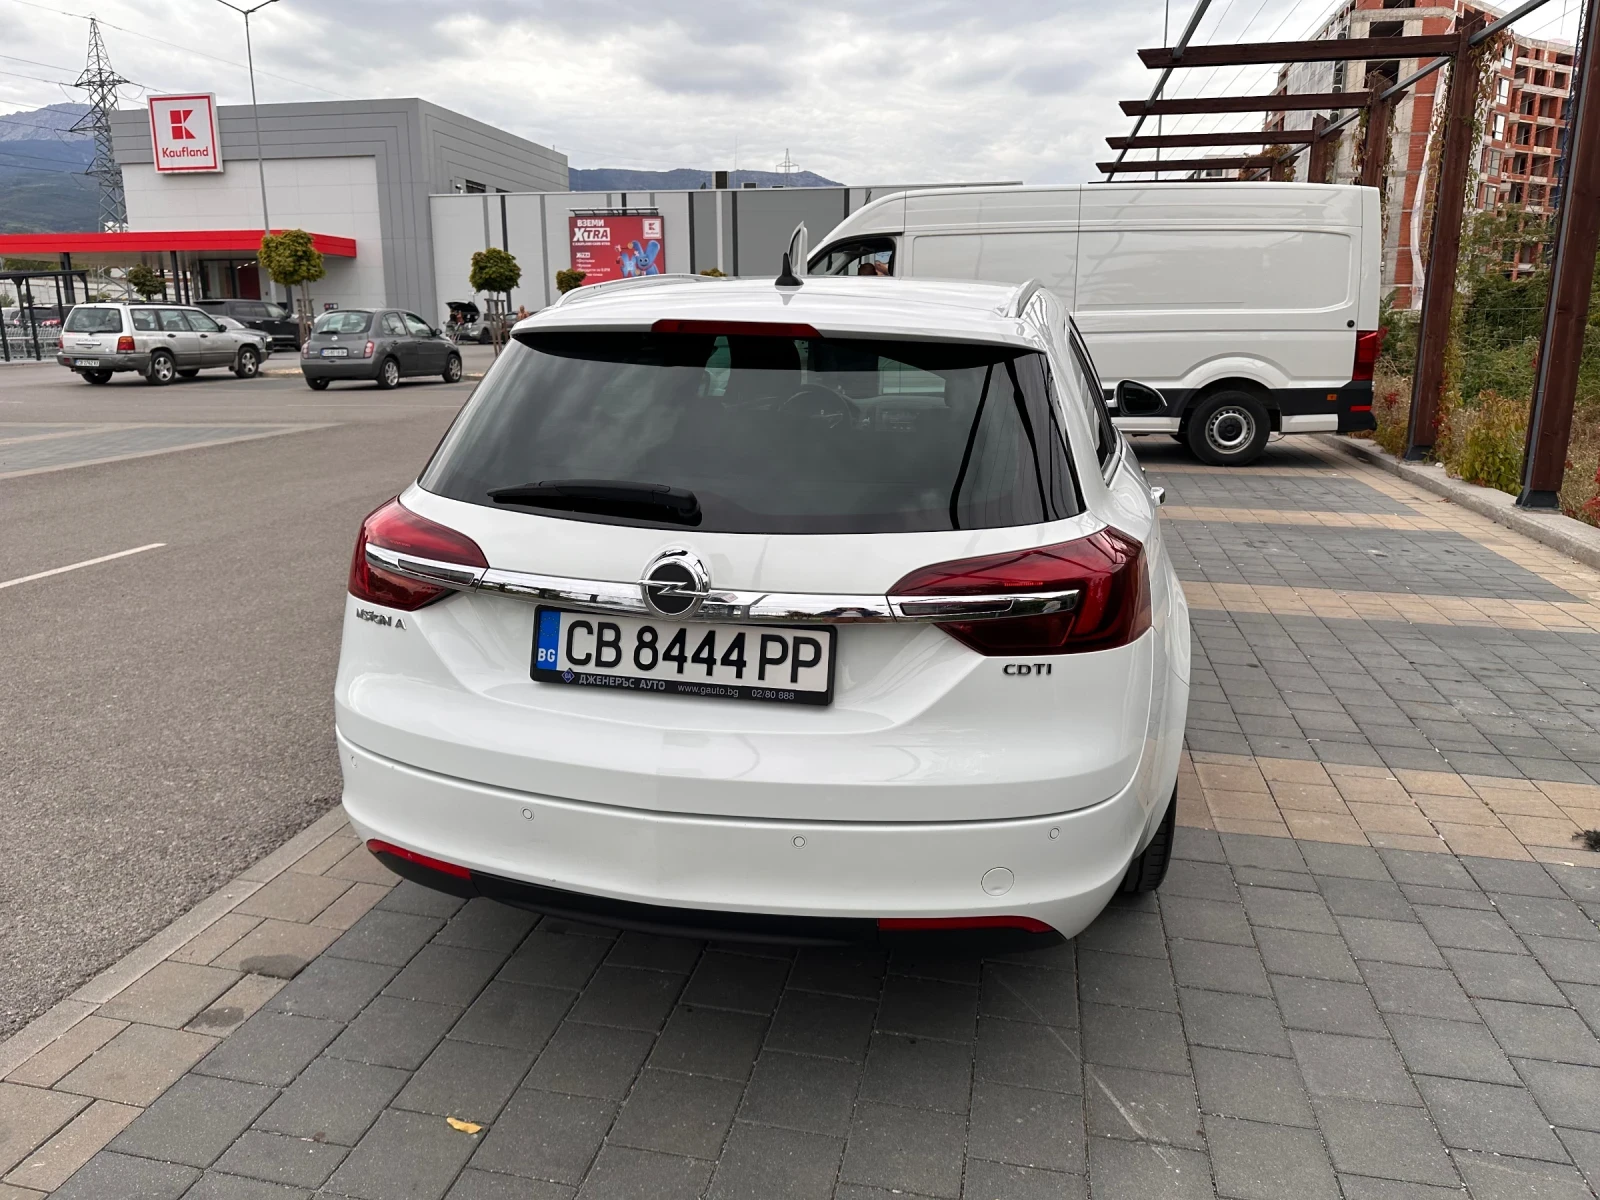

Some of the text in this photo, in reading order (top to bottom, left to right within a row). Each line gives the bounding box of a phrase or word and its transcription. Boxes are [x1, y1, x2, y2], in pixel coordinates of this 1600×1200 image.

[162, 146, 209, 158] Kaufland
[577, 219, 604, 227] ВЗЕМИ
[573, 227, 611, 242] XTRA
[537, 647, 556, 663] BG
[566, 619, 822, 684] CB 8444 PP
[1002, 663, 1052, 676] CDTI
[579, 674, 666, 690] ДЖЕНЕРЪС АУТО
[677, 684, 795, 700] www.gauto.bg 02/80 888
